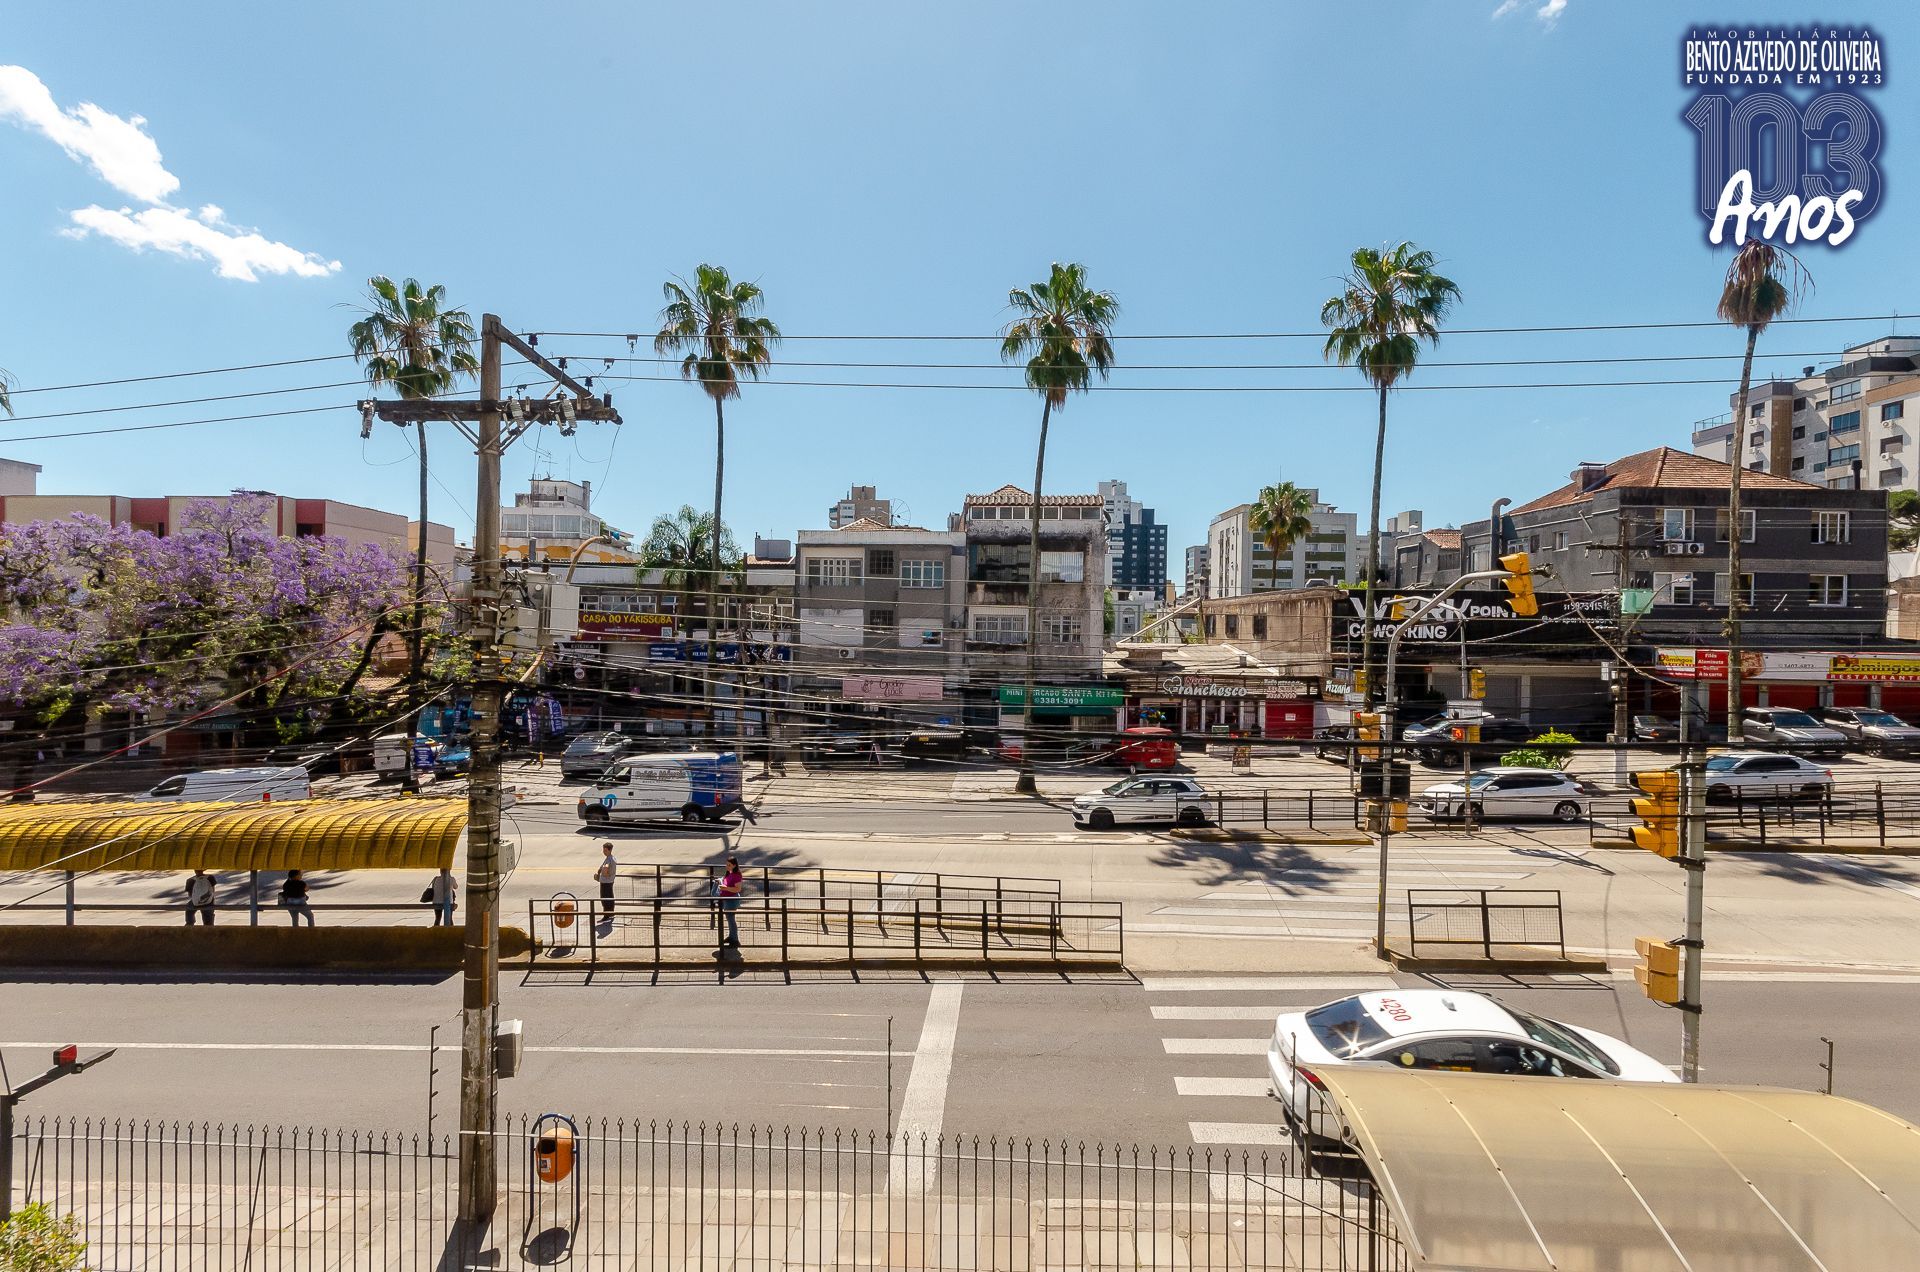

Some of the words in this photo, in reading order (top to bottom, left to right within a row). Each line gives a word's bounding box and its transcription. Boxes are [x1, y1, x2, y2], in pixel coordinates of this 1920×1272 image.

[1470, 605, 1517, 618] POIN
[583, 614, 607, 623] CASA
[608, 614, 621, 623] DO
[1006, 688, 1023, 696] MINI
[1062, 689, 1093, 697] SANTA
[1381, 998, 1412, 1021] 4280
